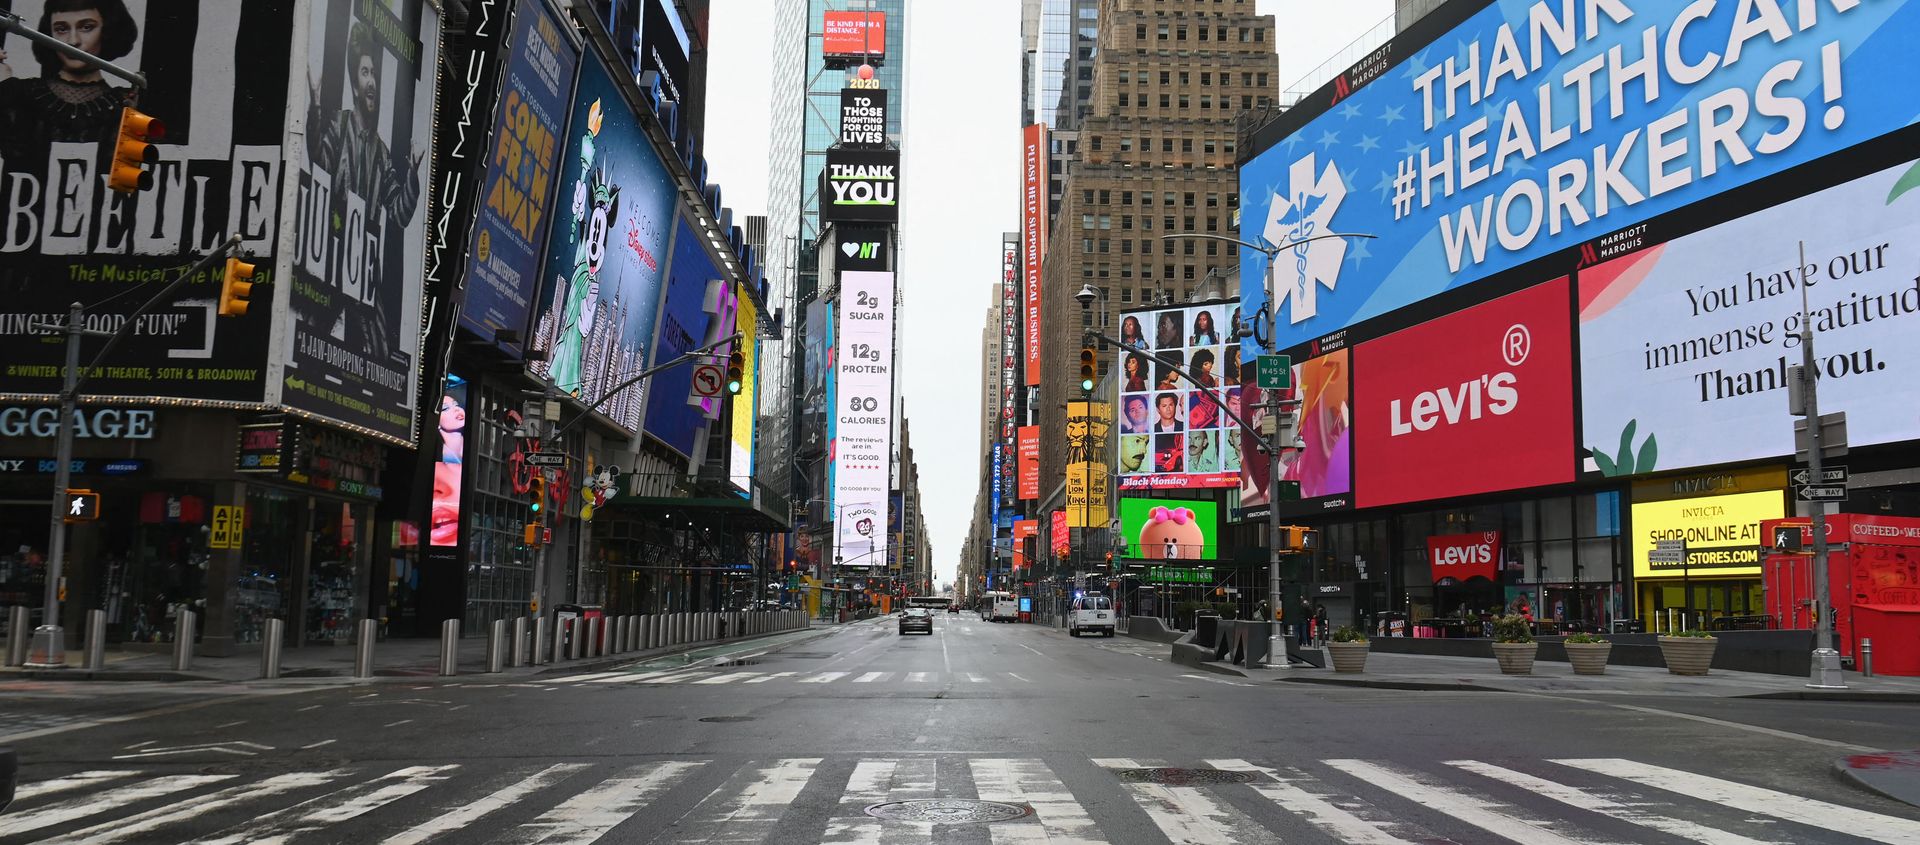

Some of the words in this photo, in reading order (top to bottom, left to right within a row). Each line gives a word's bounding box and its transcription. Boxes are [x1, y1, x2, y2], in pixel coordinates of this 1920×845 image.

[374, 5, 416, 64] BROADWAY!
[1352, 43, 1392, 76] MARRIOTT
[1352, 58, 1388, 88] MARQUIS
[512, 72, 527, 97] COME
[850, 79, 879, 89] 2020
[854, 97, 871, 107] TO
[844, 107, 883, 117] THOSE
[506, 90, 555, 166] COME
[843, 132, 883, 144] LIVES
[1438, 40, 1844, 274] WORKERS!
[831, 164, 894, 177] THANK
[831, 181, 895, 204] YOU
[1028, 186, 1036, 213] HELP
[486, 175, 542, 244] AWAY
[1028, 216, 1037, 267] SUPPORT
[1601, 224, 1647, 247] MARRIOTT
[1601, 238, 1642, 258] MARQUIS
[70, 264, 96, 282] The
[102, 264, 168, 283] Musical.
[1686, 284, 1738, 318] You
[1744, 262, 1818, 306] have
[1828, 242, 1889, 282] our
[304, 283, 331, 307] Musical
[1029, 270, 1038, 304] LOCAL
[857, 291, 879, 309] 2g
[849, 312, 884, 321] SUGAR
[1030, 307, 1038, 363] BUSINESS.
[1322, 330, 1346, 344] MARRIOTT
[852, 344, 880, 361] 12g
[1322, 340, 1344, 352] MARQUIS
[1645, 320, 1774, 371] immense
[307, 338, 364, 377] JAW-DROPPING
[18, 366, 57, 378] WINTER
[107, 367, 152, 380] THEATRE,
[157, 368, 183, 379] 50TH
[186, 368, 194, 380] &
[198, 368, 257, 381] BROADWAY
[842, 364, 887, 374] PROTEIN
[850, 396, 878, 412] 80
[840, 416, 886, 425] CALORIES
[340, 480, 364, 493] SONY
[1068, 485, 1084, 494] LION
[1123, 477, 1149, 486] Black
[1150, 476, 1188, 487] Monday
[1067, 495, 1086, 506] KING
[1324, 500, 1342, 509] swatch
[848, 509, 862, 518] TWO
[1682, 506, 1724, 518] INVICTA
[214, 508, 228, 542] ATM
[233, 509, 241, 543] ATM
[1650, 529, 1683, 545] SHOP
[1686, 526, 1738, 542] ONLINE
[1740, 523, 1757, 539] AT
[1853, 524, 1899, 536] COFFEED
